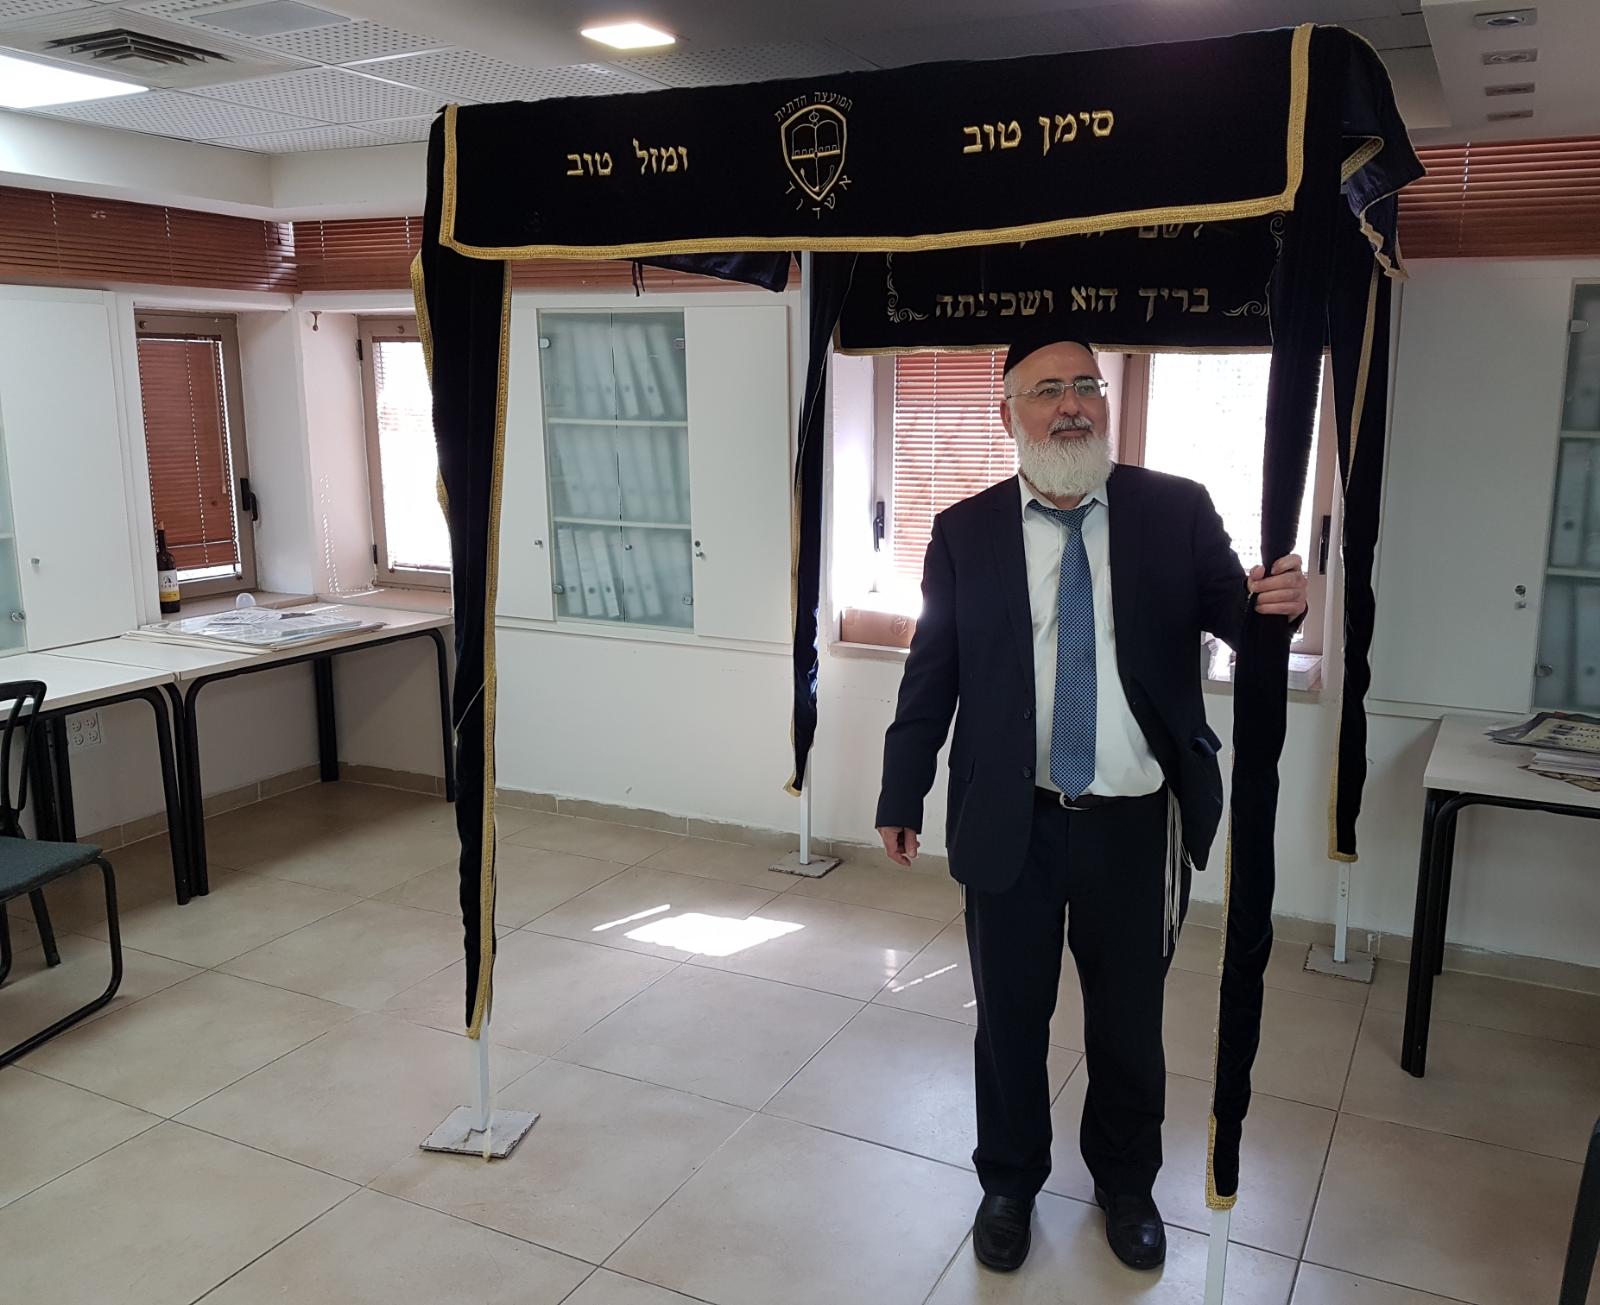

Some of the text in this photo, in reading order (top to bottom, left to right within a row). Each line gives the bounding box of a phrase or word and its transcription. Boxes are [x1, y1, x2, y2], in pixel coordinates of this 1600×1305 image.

[774, 91, 853, 122] המועצה הדתית
[963, 109, 1115, 156] סימן טוב
[566, 138, 688, 176] ומזל טוב
[1070, 285, 1118, 313] הוא
[1138, 288, 1210, 322] בריך
